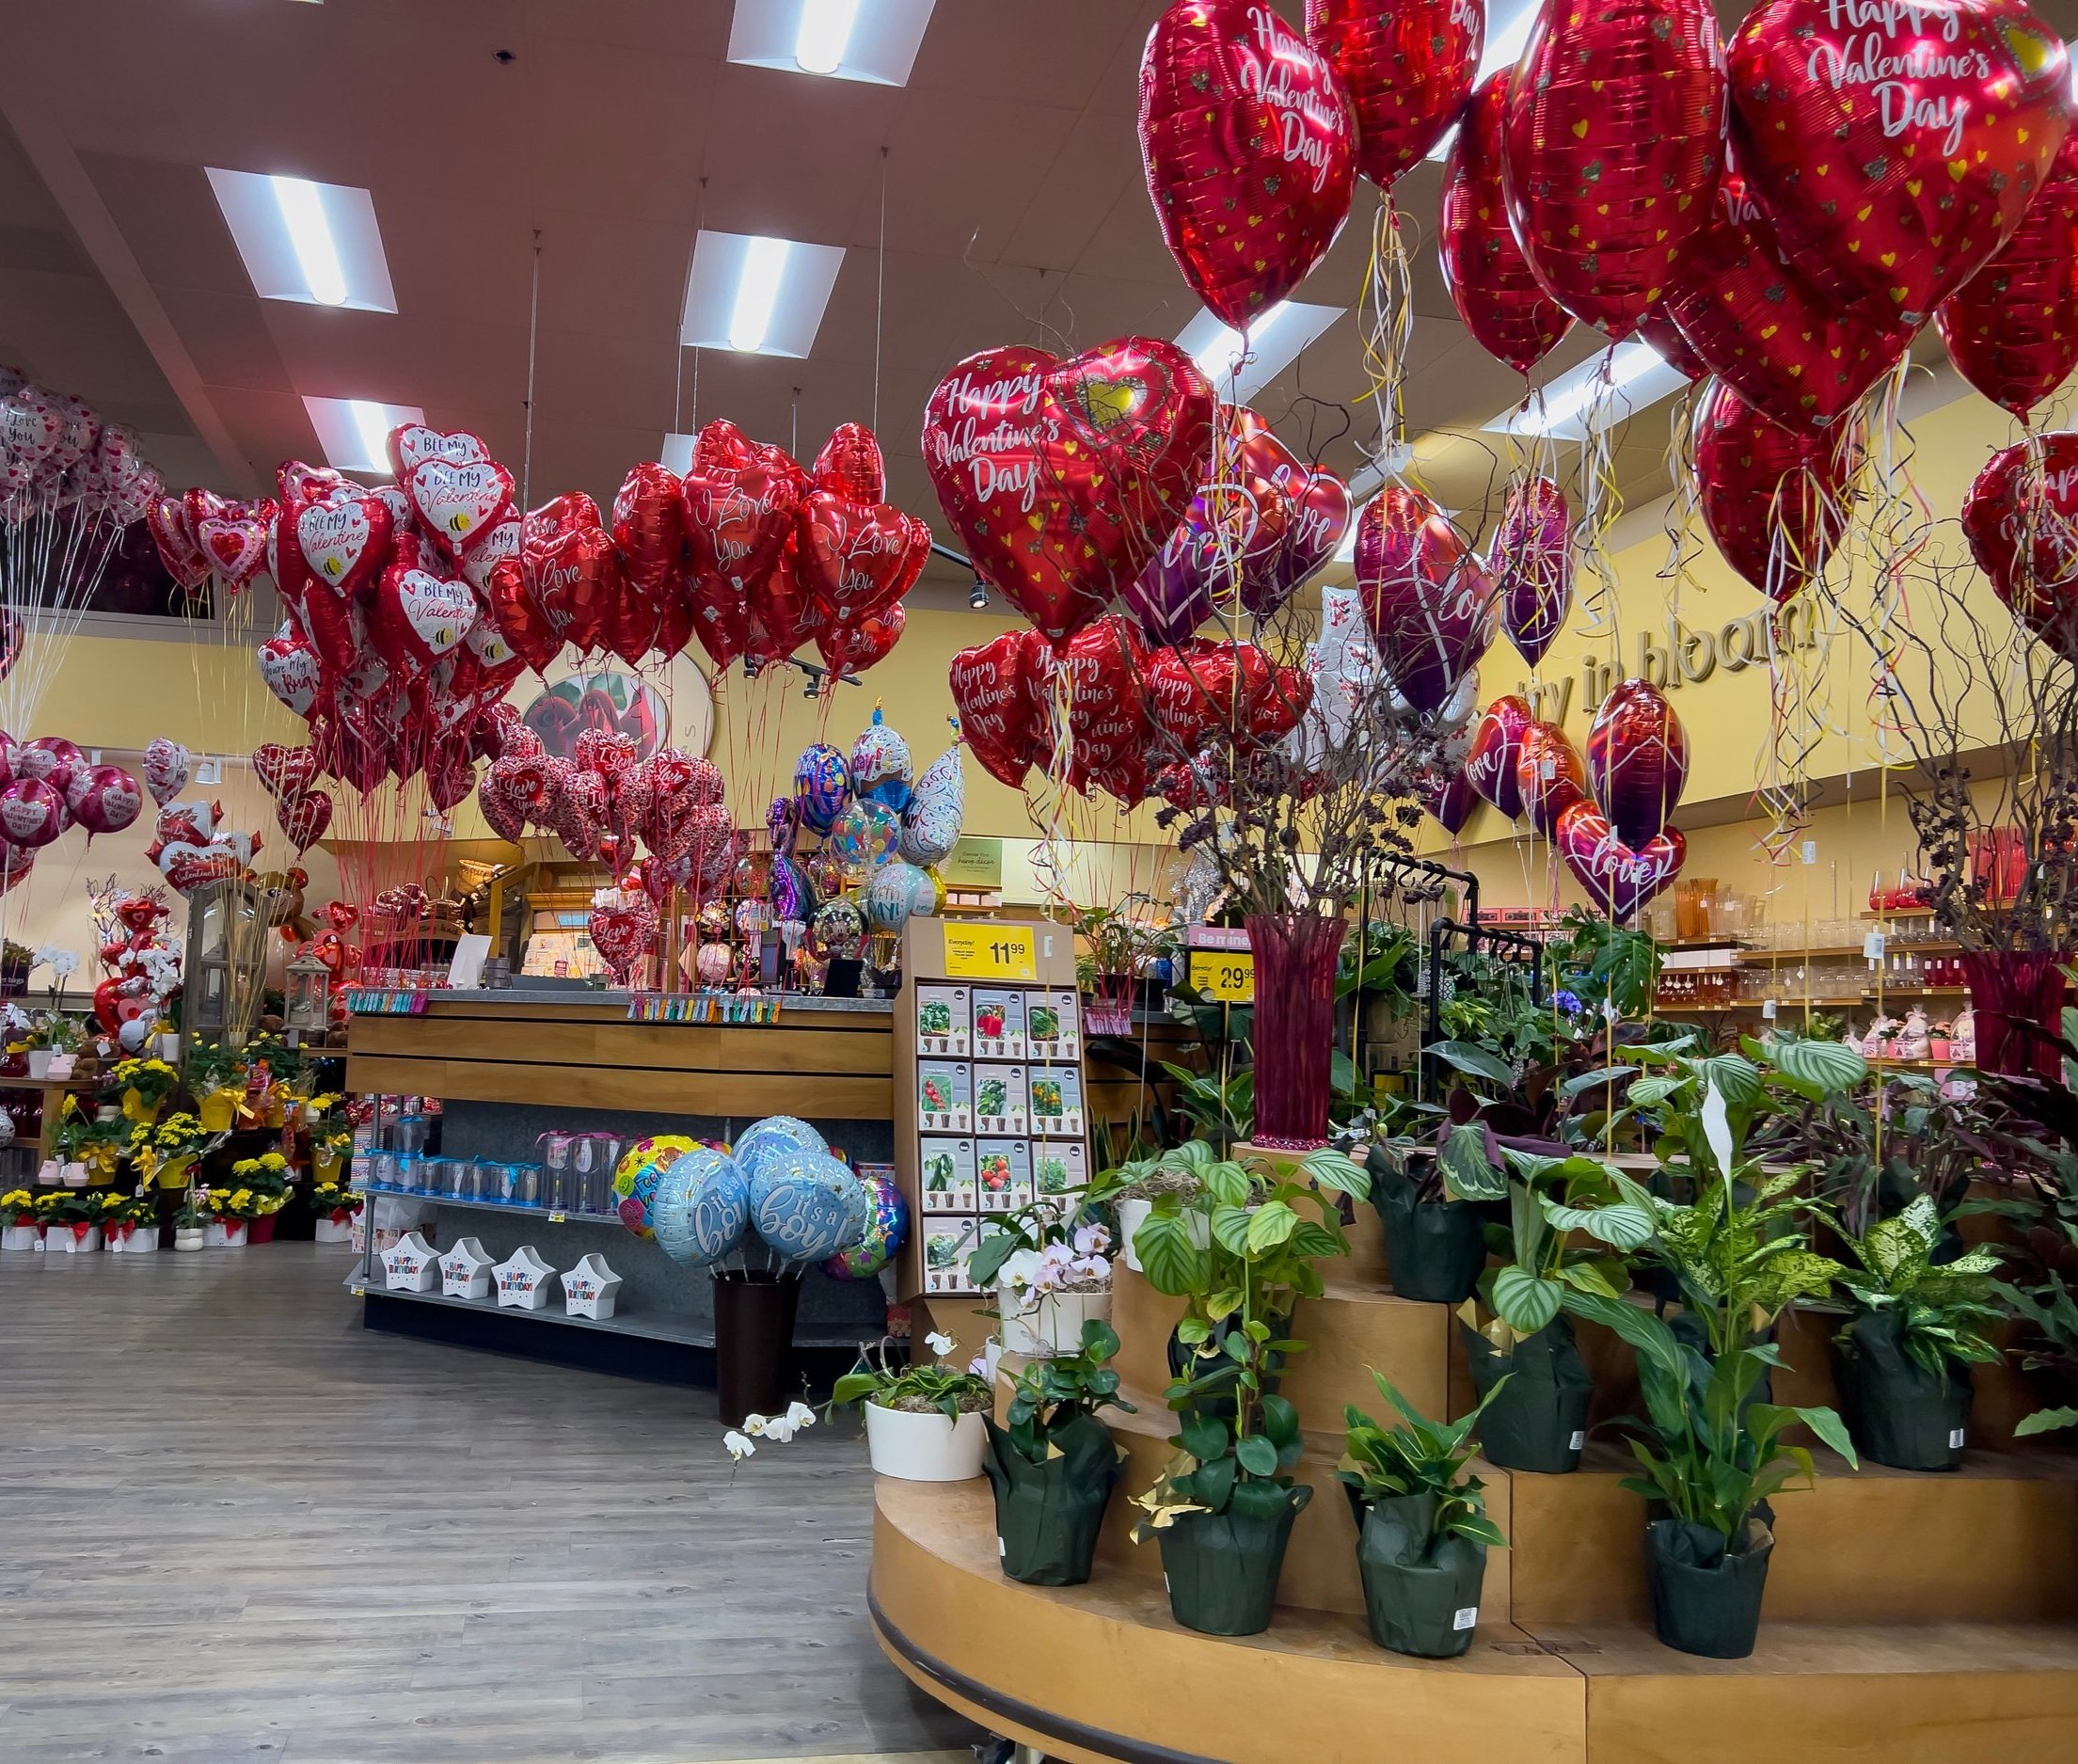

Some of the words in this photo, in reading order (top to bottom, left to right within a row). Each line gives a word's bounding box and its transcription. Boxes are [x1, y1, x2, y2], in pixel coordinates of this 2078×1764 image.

[1822, 0, 1959, 42] Happy
[1247, 8, 1332, 93] Happy
[1807, 32, 1991, 88] Valentine's
[1241, 60, 1345, 135] Valentine's
[1871, 81, 1970, 156] Day
[1281, 110, 1332, 193] Day
[945, 372, 1043, 421] Happy
[8, 427, 36, 445] You
[423, 437, 445, 453] BEE
[935, 416, 1061, 470] Valentine's
[434, 469, 455, 485] BEE
[968, 455, 1041, 514] Day
[717, 486, 776, 532] Love
[710, 527, 753, 572] You
[847, 522, 902, 560] Love
[423, 581, 445, 598] BEE
[539, 557, 583, 602] Love
[834, 555, 874, 601] You
[1637, 596, 1817, 691] bloom
[952, 660, 996, 689] Happy
[1150, 662, 1196, 707] Happy
[970, 709, 1007, 739] Day
[1074, 739, 1112, 763] Day
[503, 777, 539, 800] Love
[1198, 932, 1214, 945] Be
[792, 1194, 823, 1222] it's
[825, 1211, 838, 1227] a
[393, 1256, 415, 1265] HAPPY
[449, 1262, 468, 1273] HAPPY
[506, 1272, 529, 1282] HAPPY
[572, 1280, 592, 1291] HAPPY
